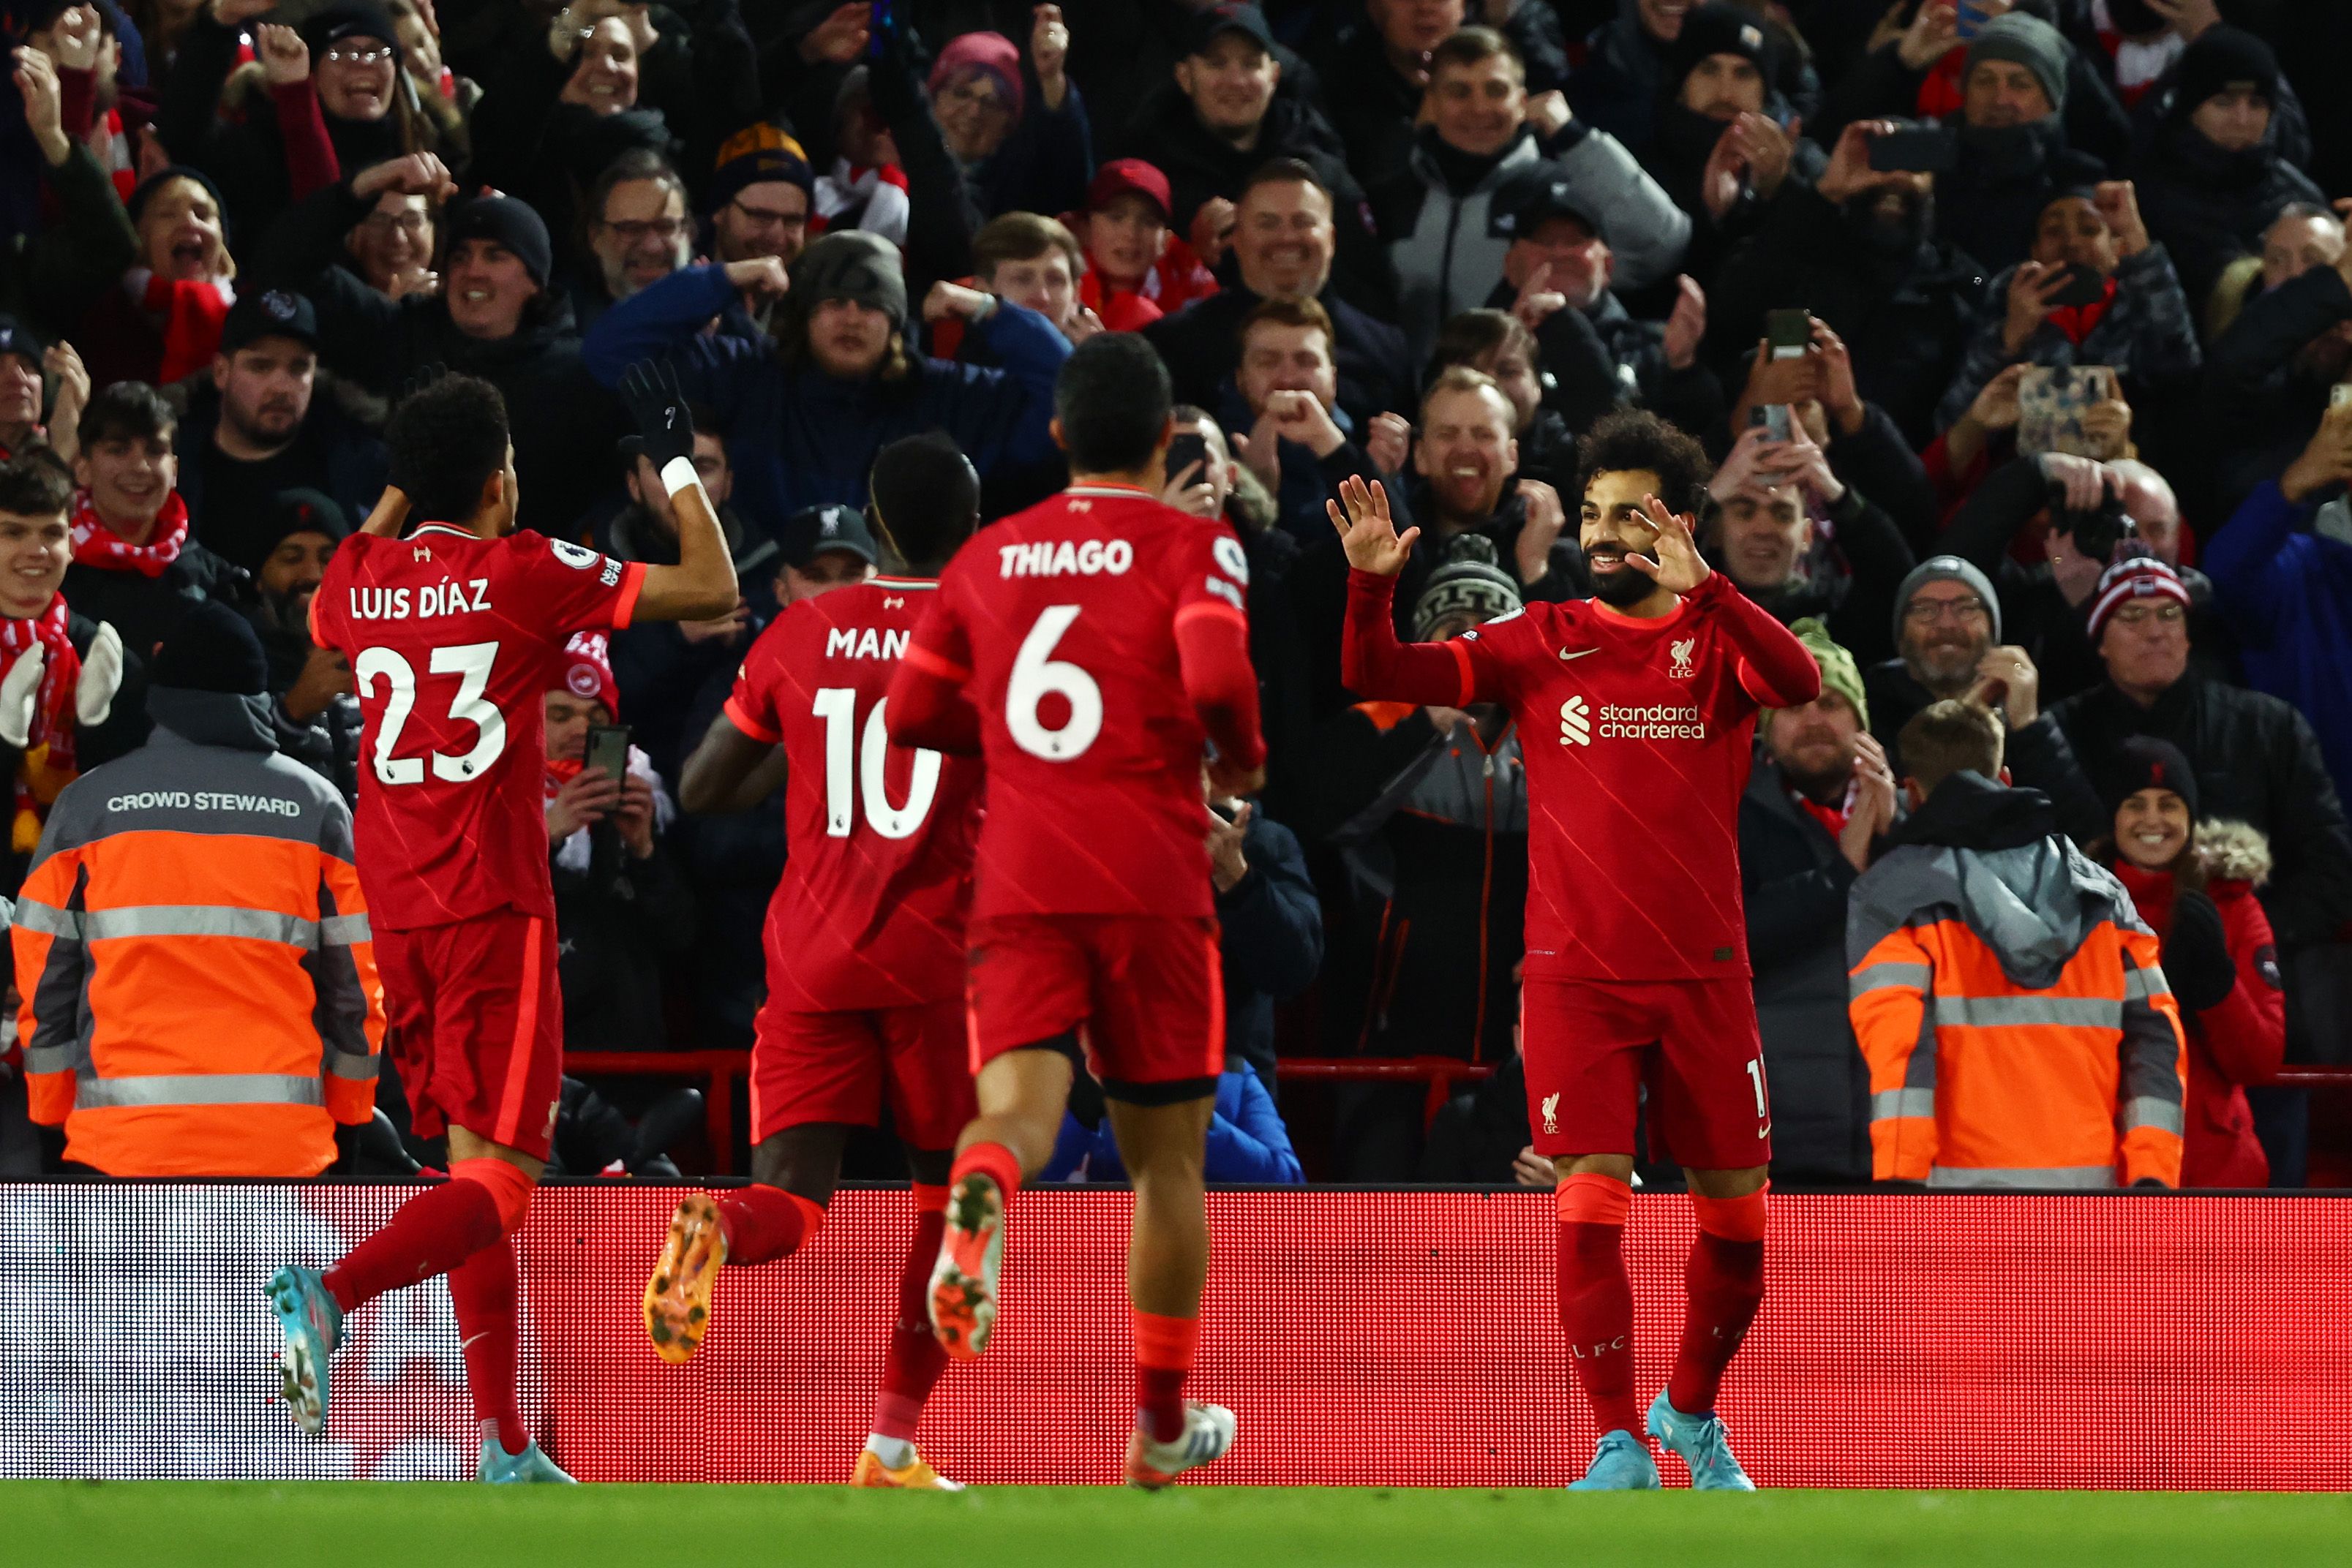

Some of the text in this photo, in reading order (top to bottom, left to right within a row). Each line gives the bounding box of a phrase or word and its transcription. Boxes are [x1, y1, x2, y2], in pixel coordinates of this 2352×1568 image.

[999, 539, 1133, 579] THIAGO
[350, 576, 492, 619] LUIS DÍAZ
[826, 627, 910, 660] MAN
[1006, 604, 1103, 762] 6
[356, 641, 506, 785] 23
[1599, 704, 1697, 721] standard
[1599, 721, 1705, 739] chartered
[812, 687, 942, 839] 10
[108, 792, 300, 817] CROWD STEWARD
[1747, 1053, 1765, 1118] 1
